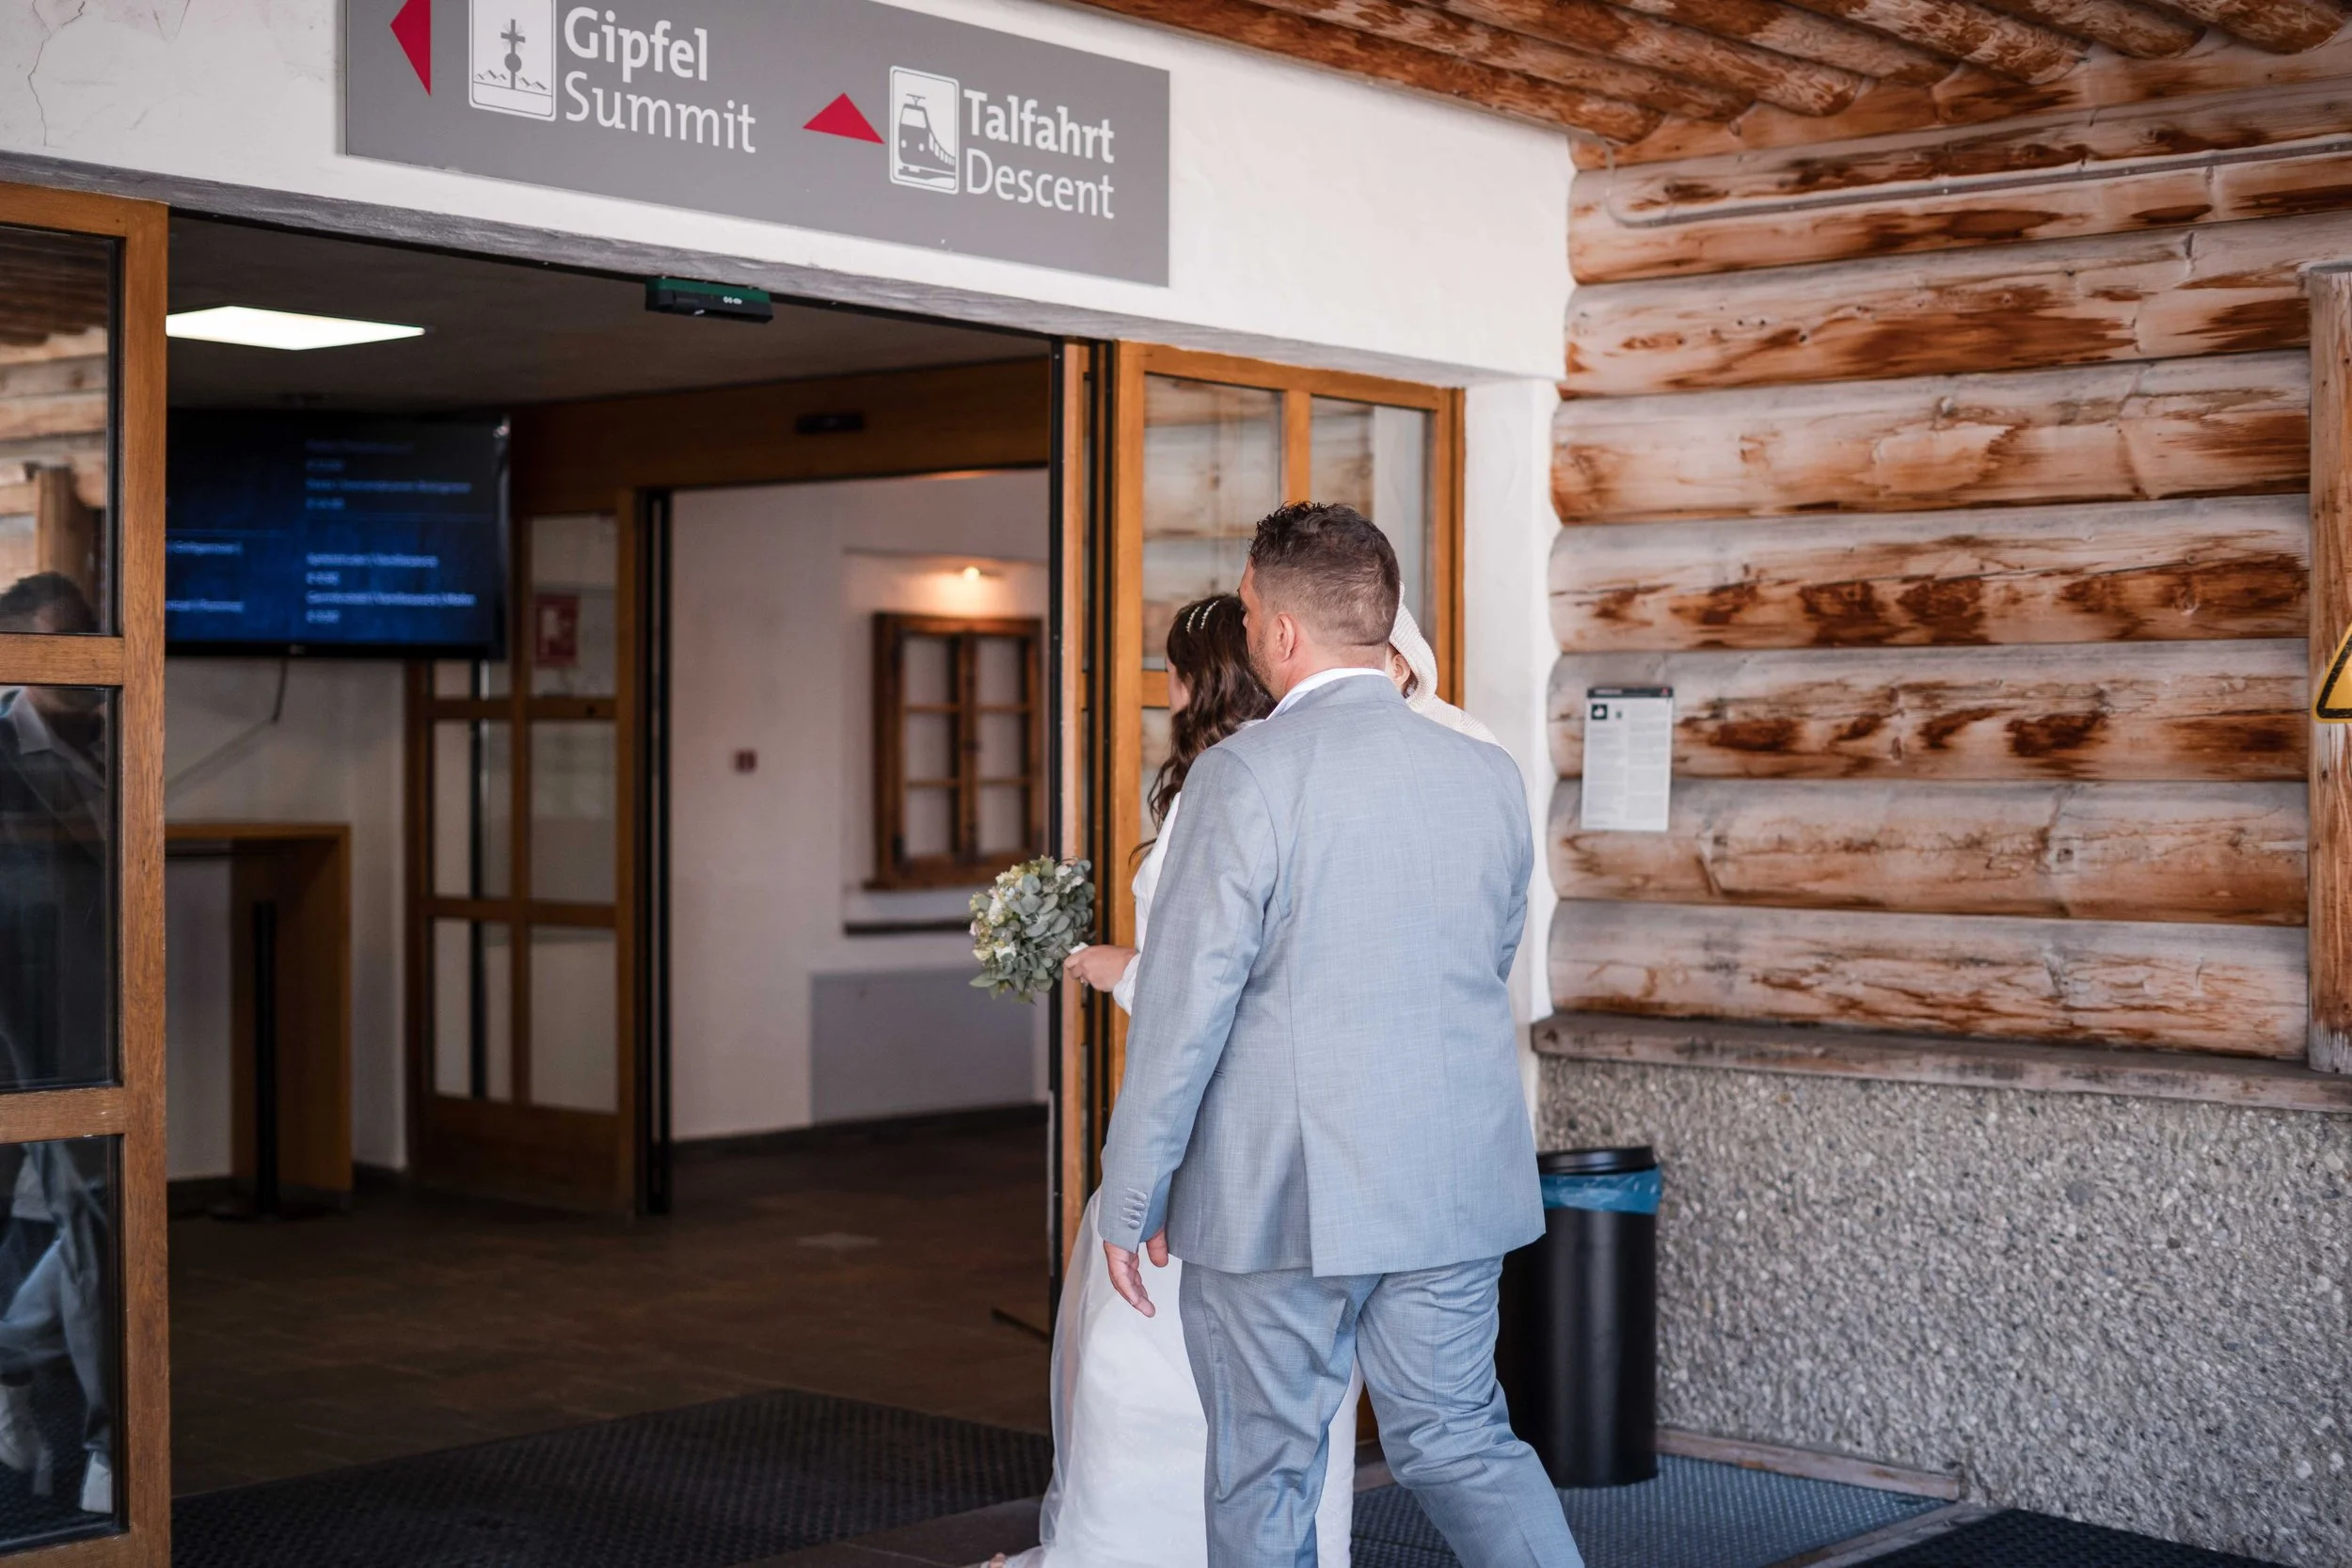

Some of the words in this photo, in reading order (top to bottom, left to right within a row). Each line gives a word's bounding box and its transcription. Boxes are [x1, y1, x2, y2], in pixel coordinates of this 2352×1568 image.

[564, 7, 708, 84] Gipfel
[564, 71, 756, 153] Summit
[962, 88, 1116, 164] Talfahrt
[966, 148, 1116, 220] Descent
